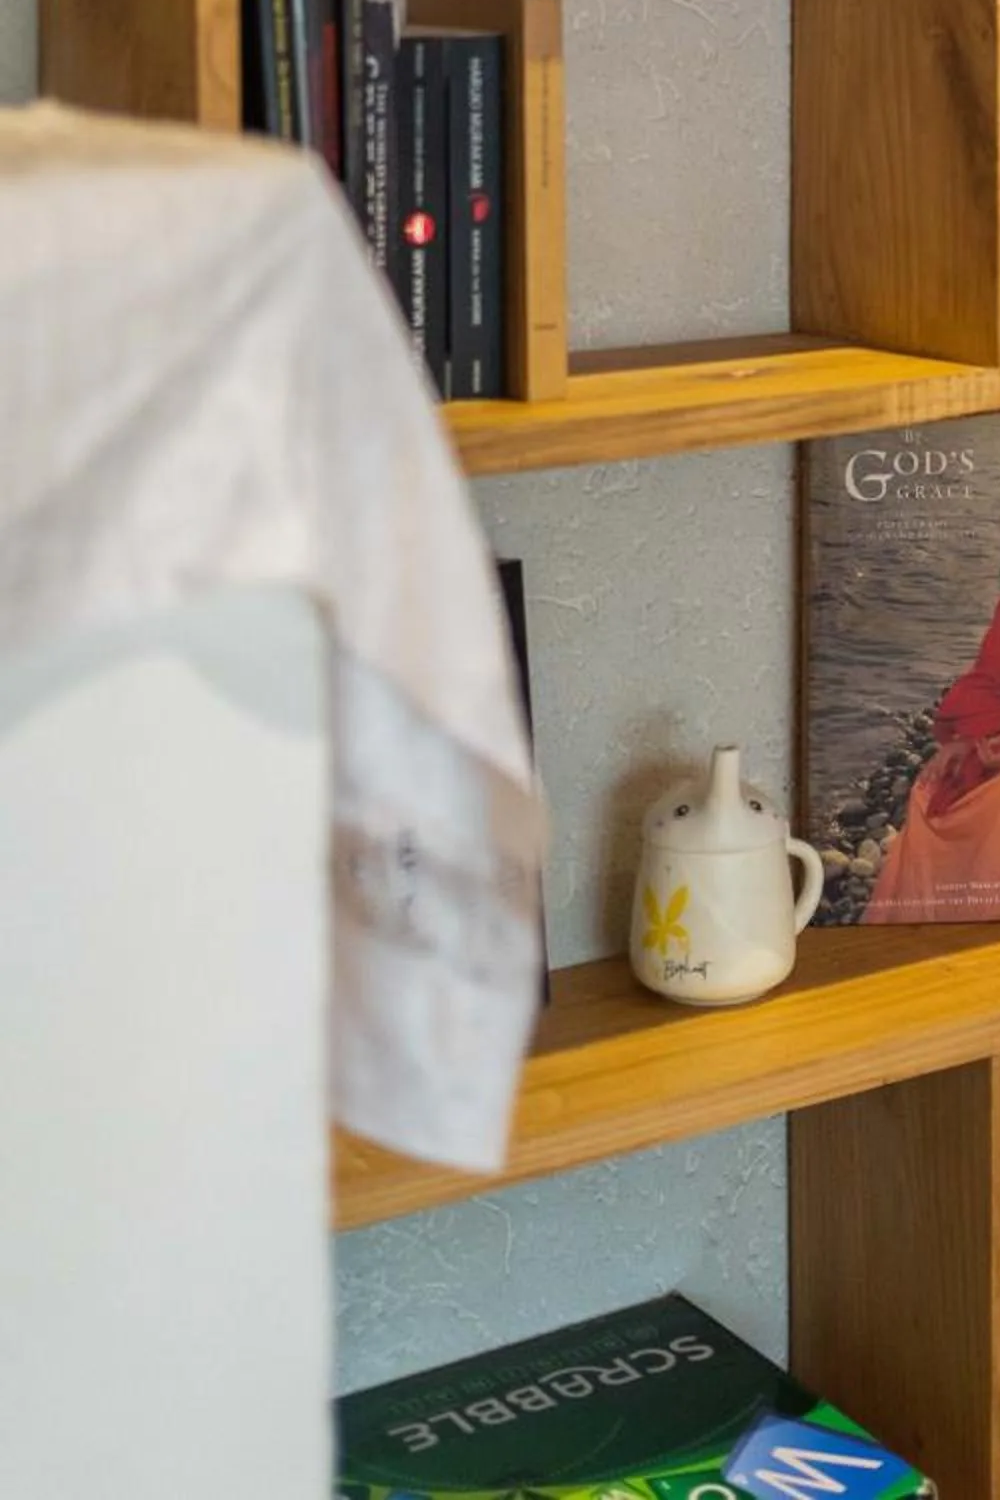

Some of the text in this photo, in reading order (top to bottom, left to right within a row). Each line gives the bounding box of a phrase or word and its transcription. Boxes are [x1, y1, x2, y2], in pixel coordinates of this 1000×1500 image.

[469, 57, 482, 189] HARUKI MURAKAMI
[845, 449, 975, 502] GOD'S
[387, 1335, 716, 1455] SCRABBLE
